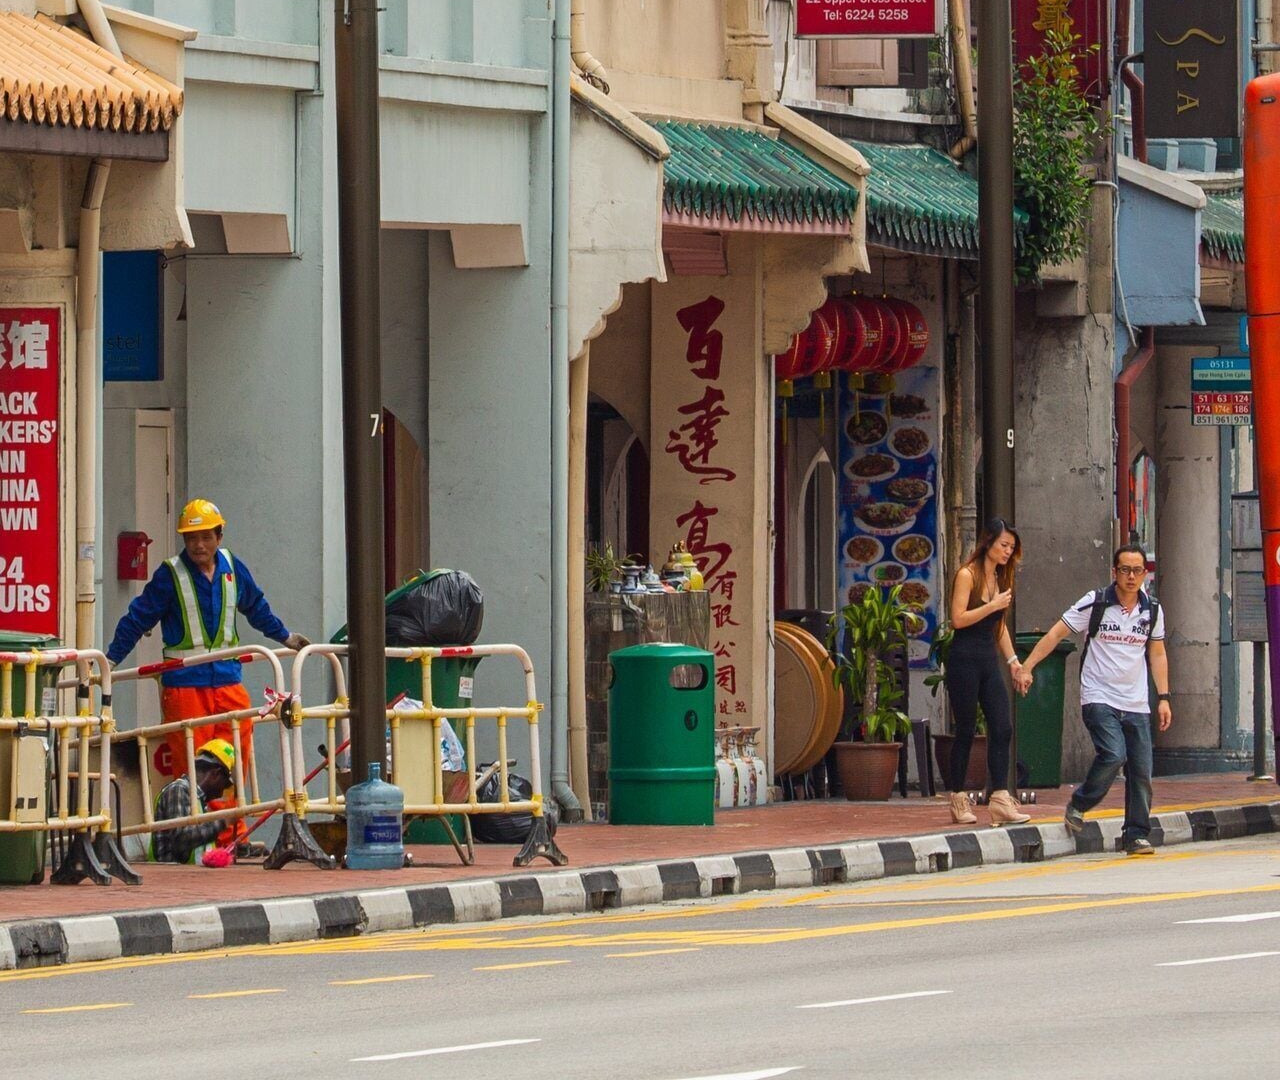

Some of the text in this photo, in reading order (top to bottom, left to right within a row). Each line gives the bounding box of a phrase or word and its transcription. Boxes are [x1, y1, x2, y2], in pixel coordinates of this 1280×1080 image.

[824, 9, 909, 20] Tel: 6224 5258
[370, 414, 379, 437] 7
[1196, 416, 1249, 424] 851 961 970
[1006, 428, 1014, 449] 9
[710, 571, 740, 695] 有限公司
[1098, 624, 1120, 632] TRADA
